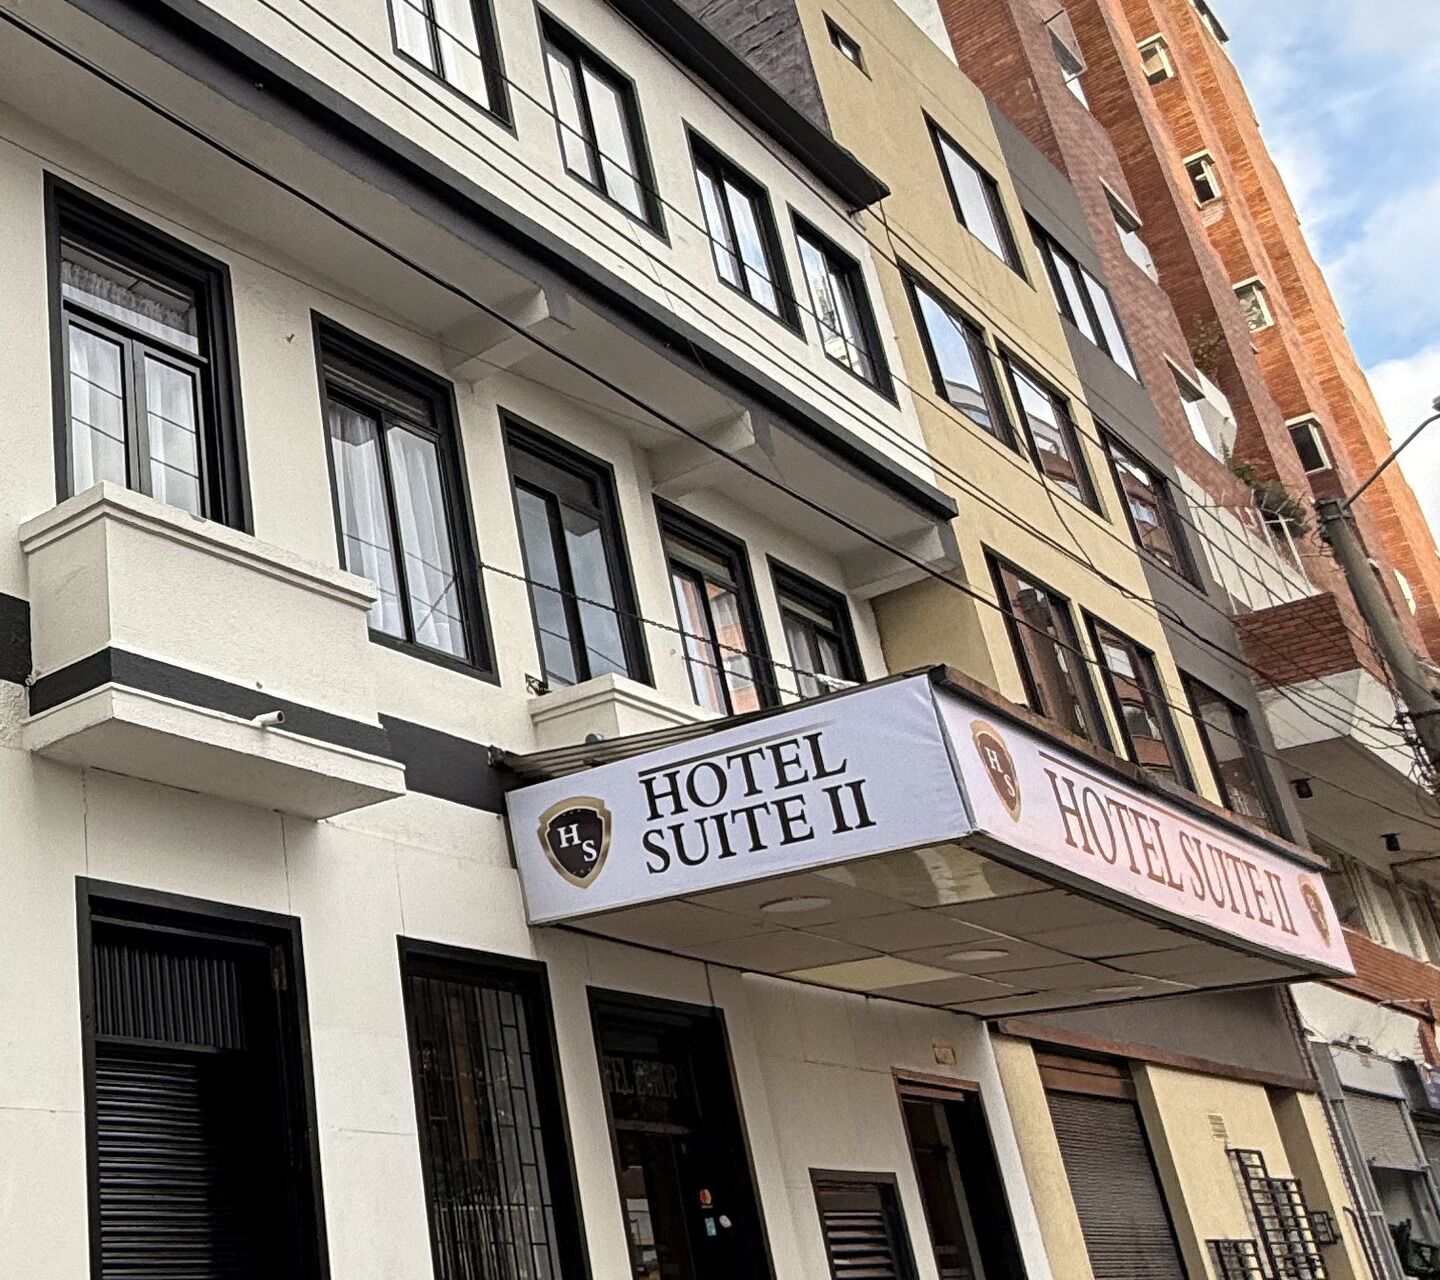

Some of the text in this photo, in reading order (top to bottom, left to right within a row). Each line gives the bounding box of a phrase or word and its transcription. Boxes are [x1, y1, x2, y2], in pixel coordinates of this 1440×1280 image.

[639, 731, 848, 822] HOTEL
[641, 778, 878, 875] SUITE II
[1044, 767, 1299, 937] HOTEL SUITE II
